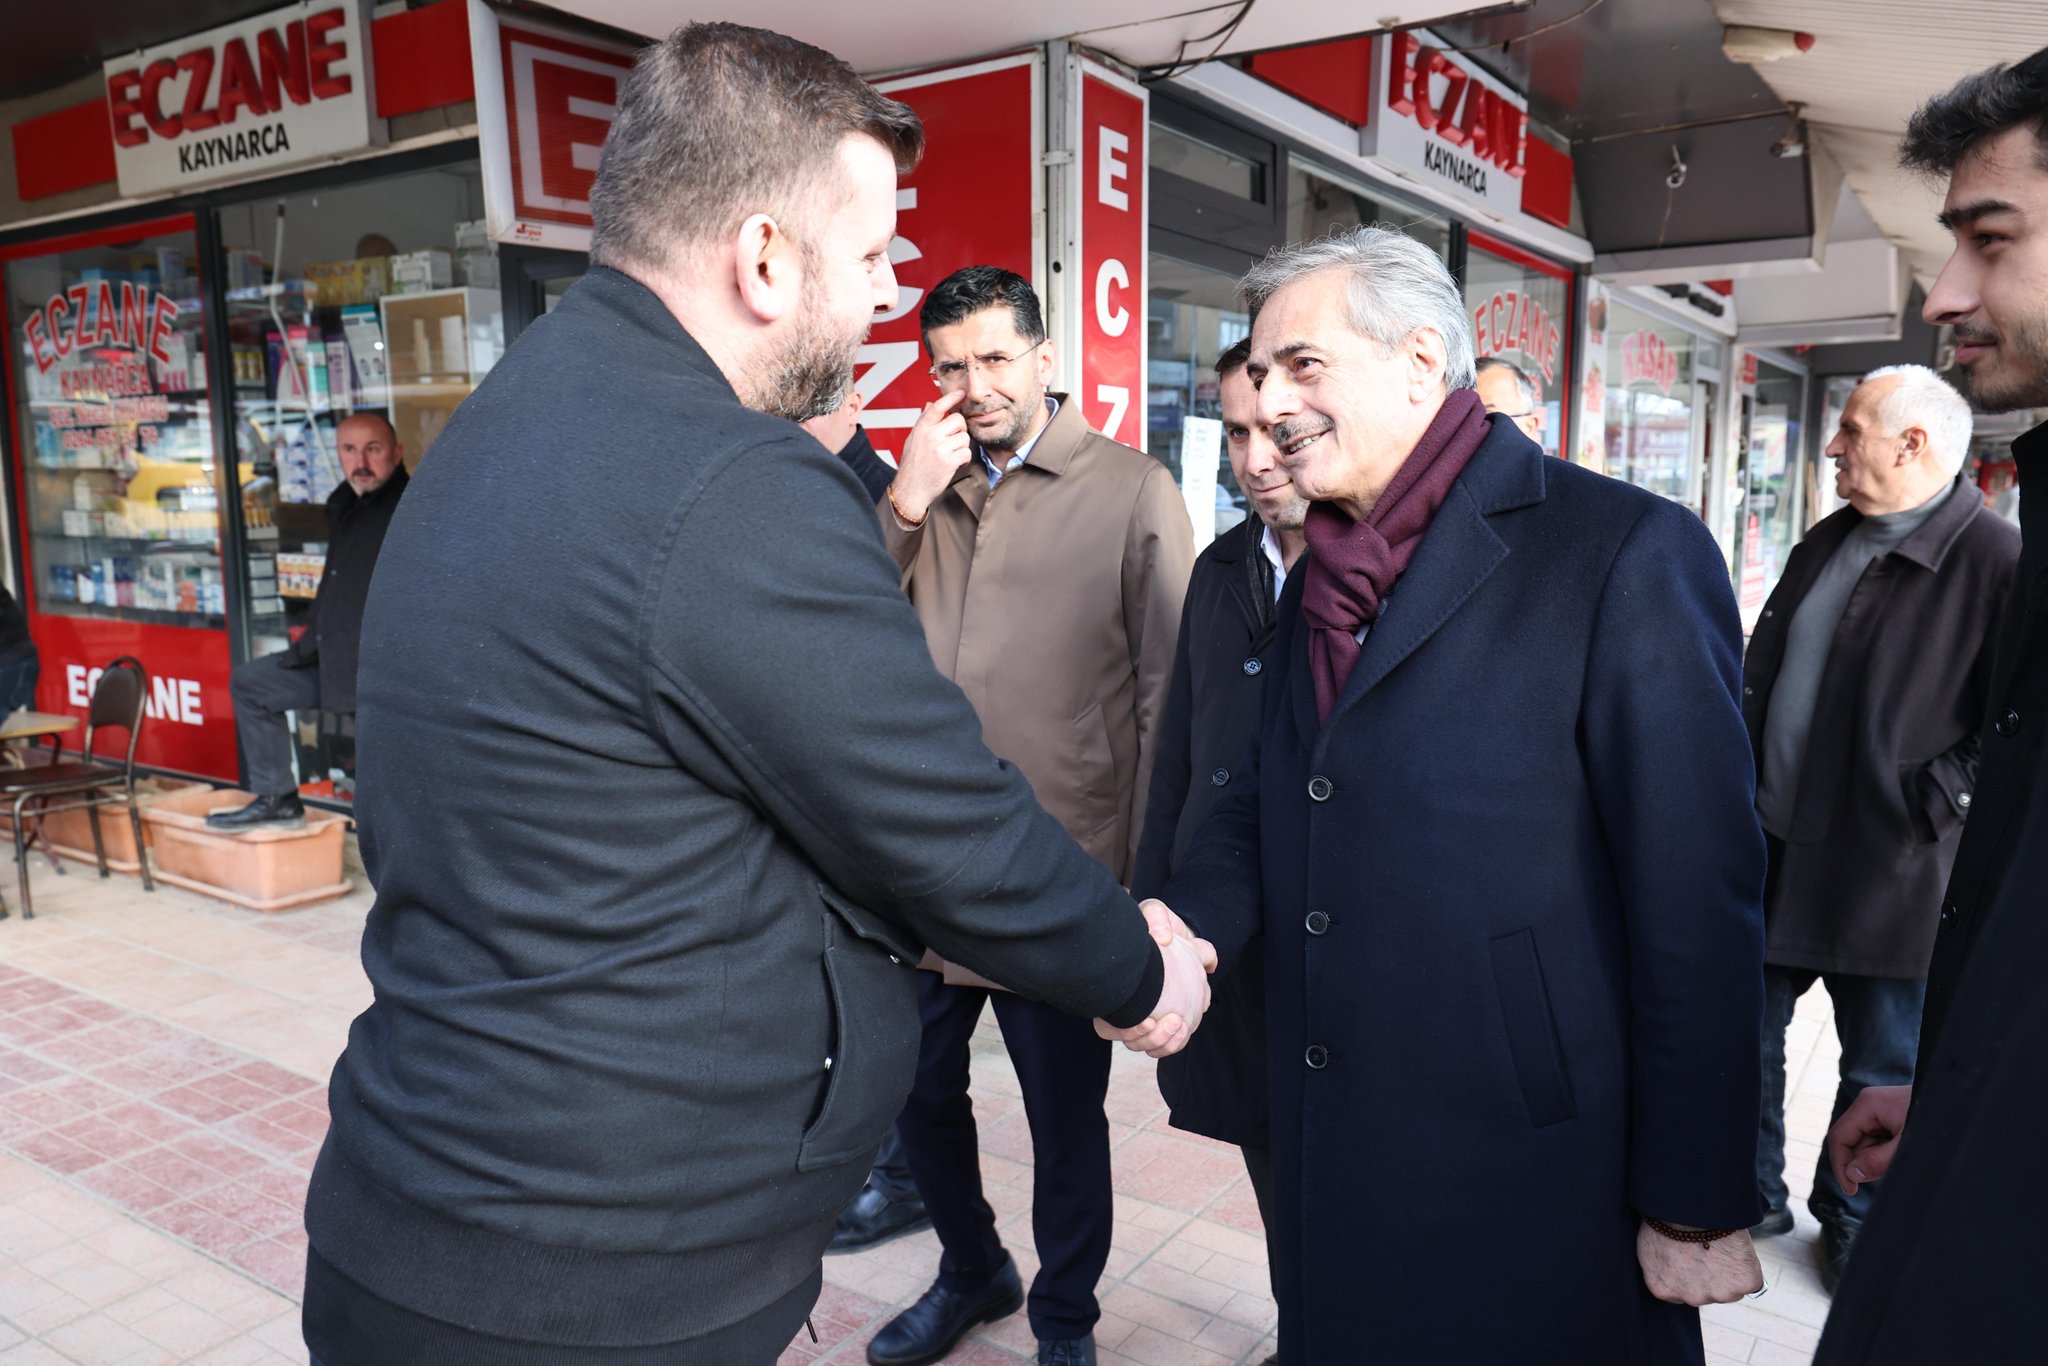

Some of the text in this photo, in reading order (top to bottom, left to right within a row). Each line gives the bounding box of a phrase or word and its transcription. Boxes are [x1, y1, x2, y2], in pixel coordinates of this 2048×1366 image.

[108, 7, 352, 148] ECZANE
[1389, 30, 1530, 178] ECZANE
[179, 123, 290, 173] KAYNARCA
[1424, 141, 1487, 196] KAYNARCA
[23, 280, 180, 376] ECZANE
[1474, 292, 1560, 386] ECZANE
